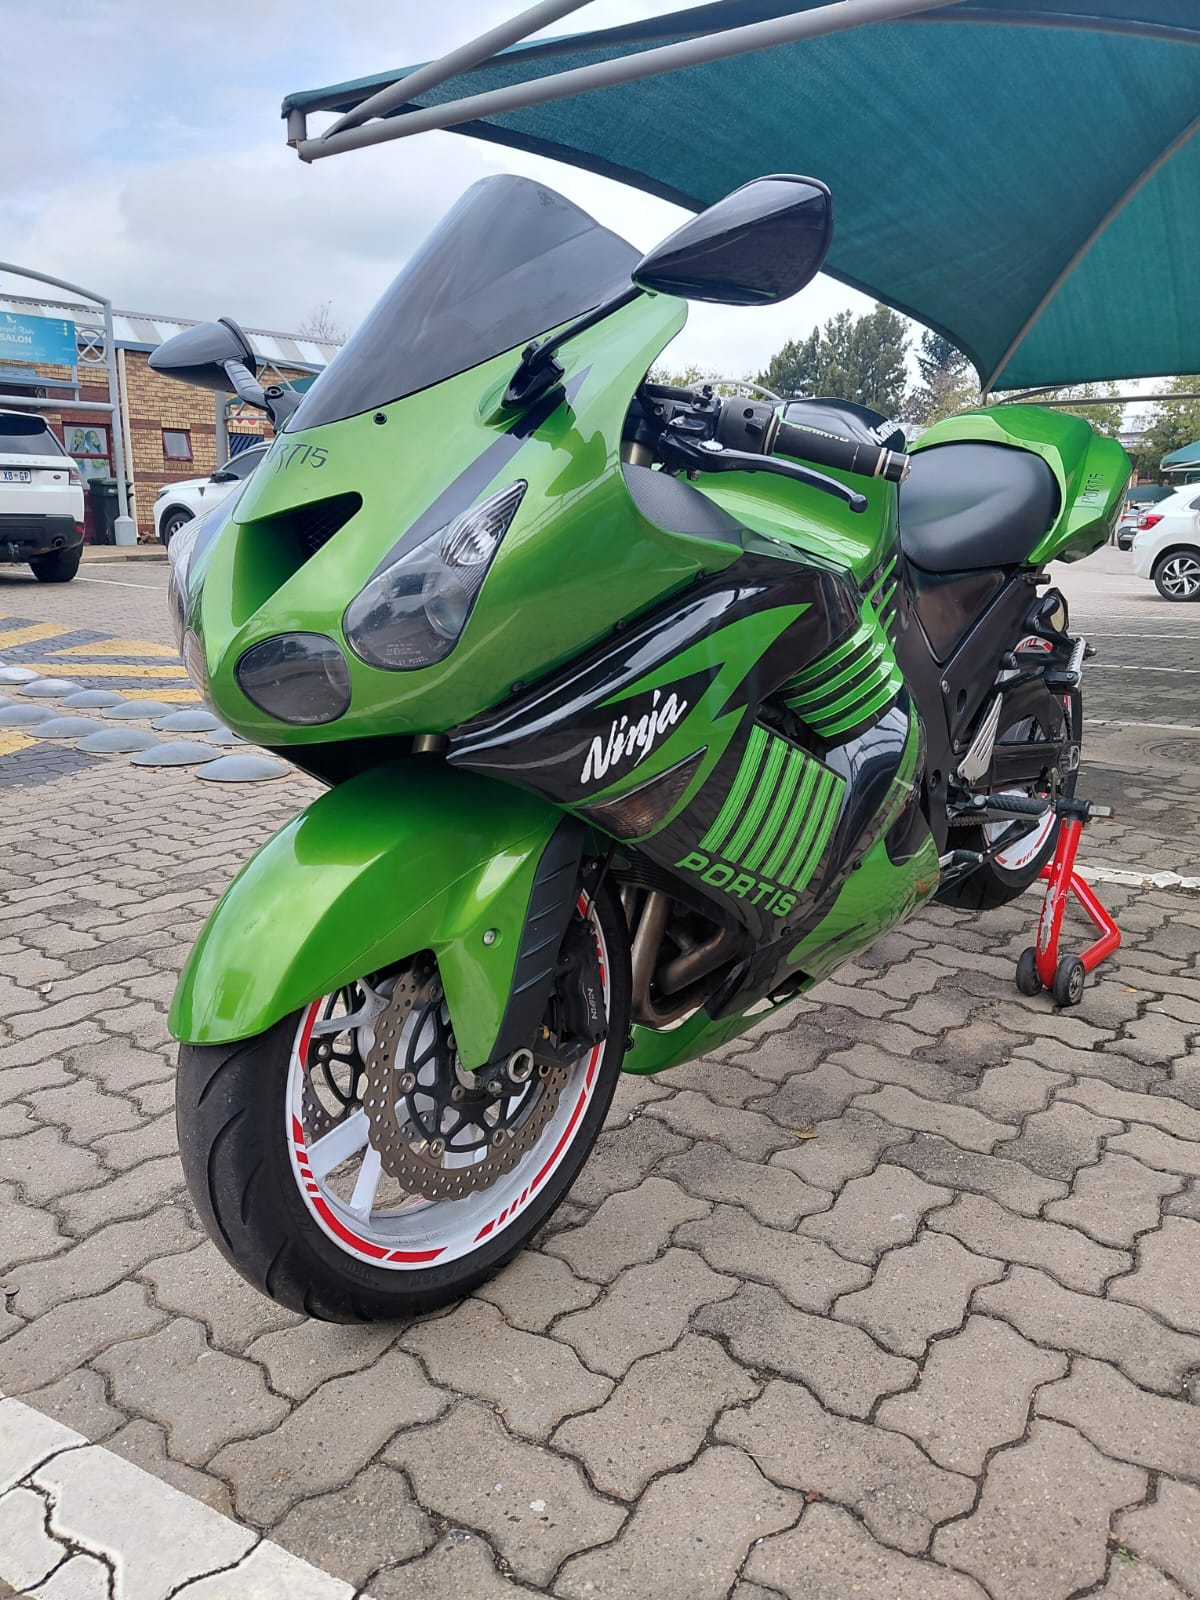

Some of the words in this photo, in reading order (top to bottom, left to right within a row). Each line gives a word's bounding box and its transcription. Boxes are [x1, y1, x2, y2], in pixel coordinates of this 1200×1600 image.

[0, 333, 32, 345] SALON
[19, 471, 29, 481] GP
[580, 689, 687, 783] Ninja
[674, 851, 798, 917] PORTIS
